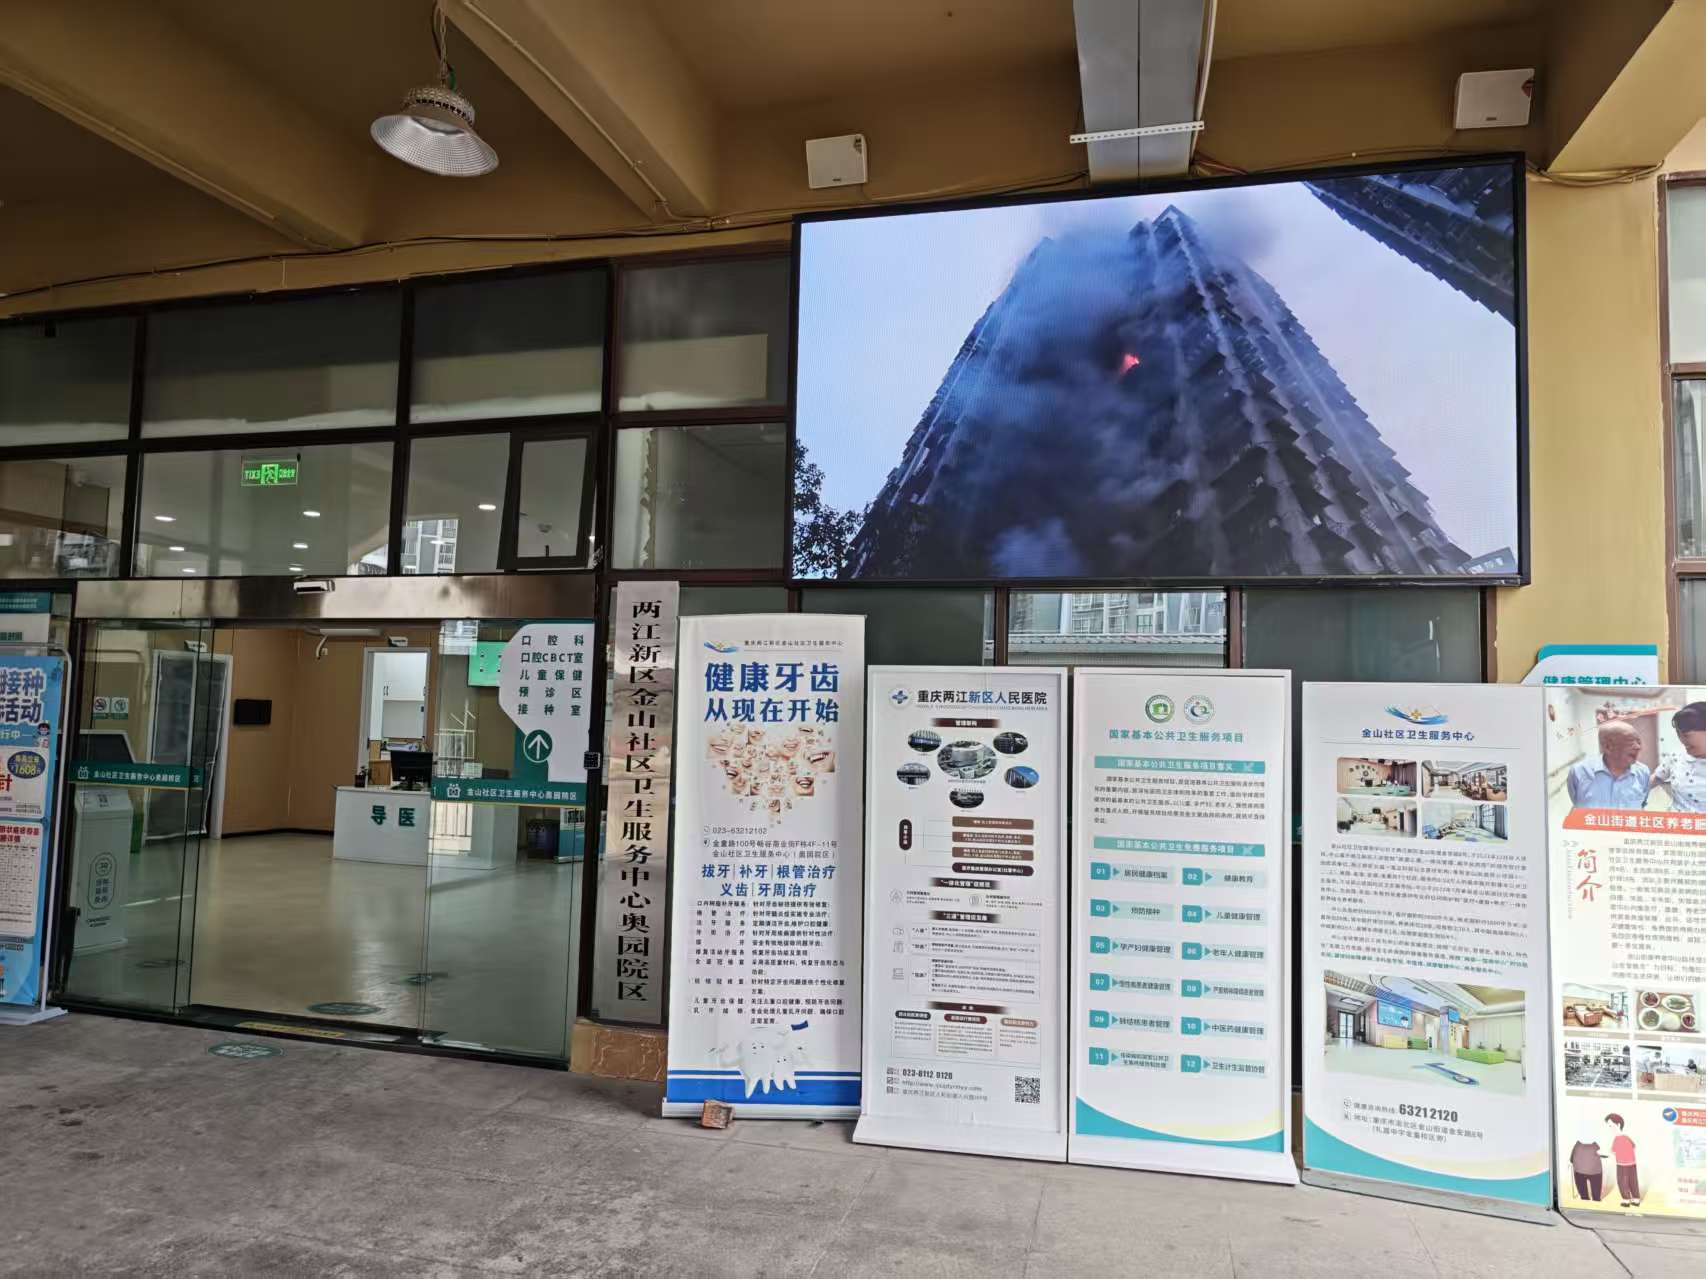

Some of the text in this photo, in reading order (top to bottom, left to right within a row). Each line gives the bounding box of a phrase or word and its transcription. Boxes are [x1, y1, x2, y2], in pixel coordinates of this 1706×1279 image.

[521, 635, 584, 646] 口腔科
[521, 652, 584, 663] 口腔CBCT室
[519, 669, 583, 681] 儿童保健
[705, 662, 839, 692] 健康牙齿
[518, 686, 582, 698] 预诊区
[917, 690, 1048, 704] 重庆两江新区人民医院
[517, 703, 582, 716] 接种室
[704, 697, 839, 723] 从现在开始
[1108, 729, 1244, 743] 国家基本公共卫生服务项目
[1361, 728, 1475, 741] 金山社区卫生服务中心
[617, 600, 662, 1001] 两江新区金山社区卫生服务中心奥园院区
[371, 805, 416, 827] 导医
[702, 864, 837, 880] 拔牙 补牙 根管治疗
[1124, 869, 1168, 879] 居民健康档案
[1223, 874, 1254, 883] 健康教育
[1576, 849, 1603, 902] 简介
[720, 882, 817, 898] 义齿 牙周治疗
[1130, 907, 1161, 916] 预防接种
[1216, 912, 1261, 921] 儿童健康管理
[1119, 944, 1171, 954] 孕产妇健康管理
[1212, 949, 1264, 959] 老年人健康管理
[1211, 1023, 1264, 1035] 中医药健康管理
[1399, 1103, 1459, 1122] 63212120
